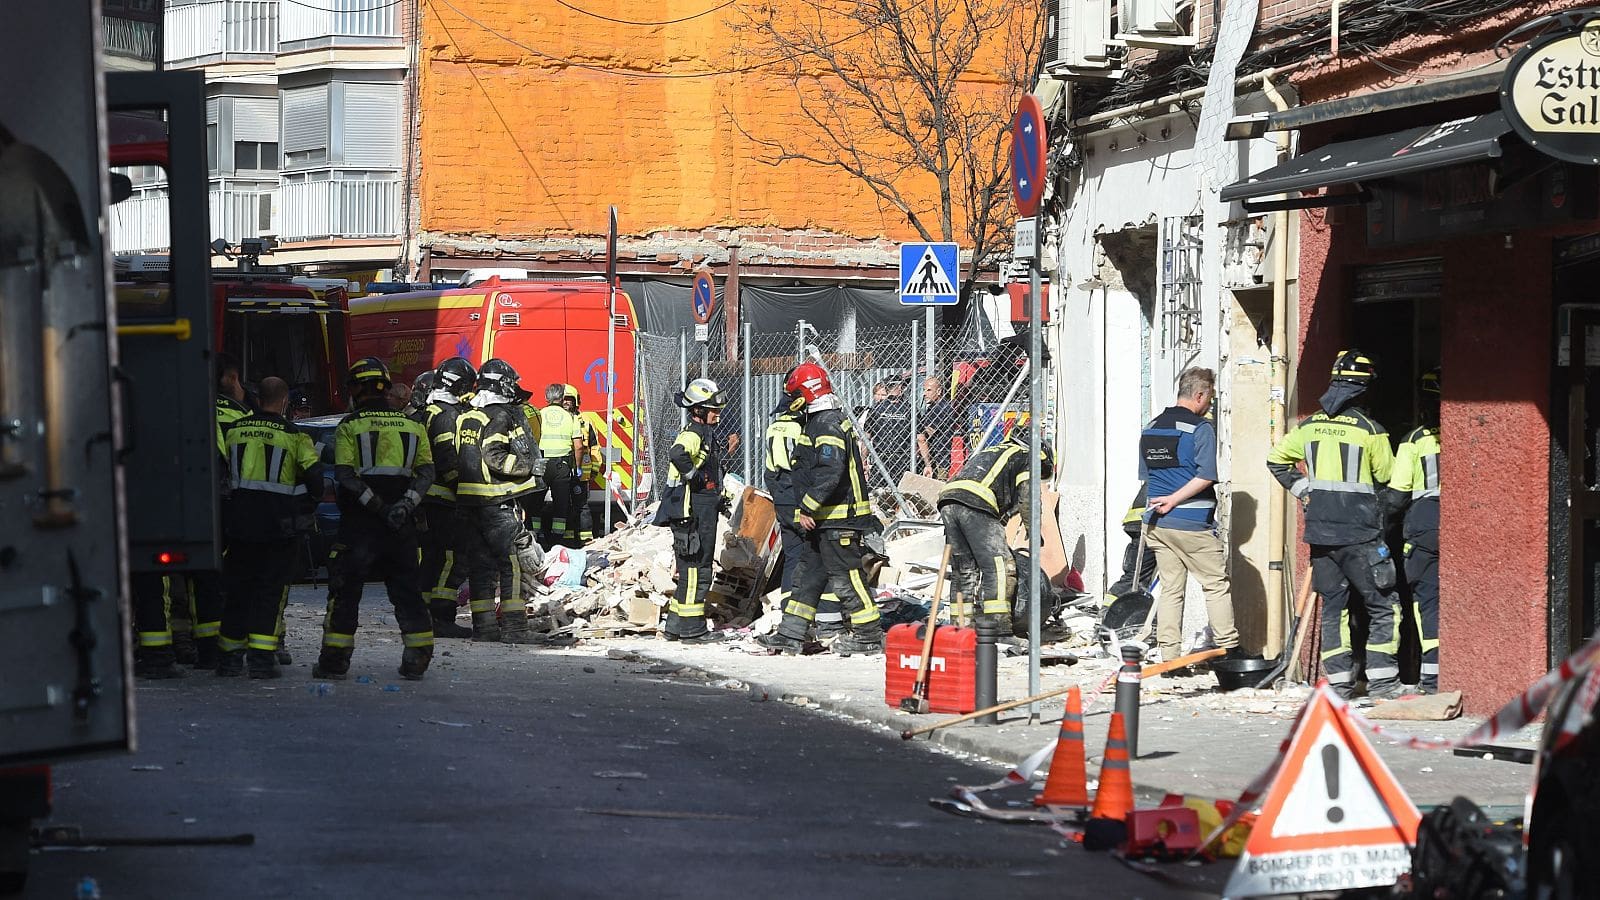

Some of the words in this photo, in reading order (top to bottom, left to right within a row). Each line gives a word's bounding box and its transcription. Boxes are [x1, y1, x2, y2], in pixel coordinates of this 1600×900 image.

[1541, 92, 1600, 125] Gal
[236, 420, 285, 430] BOMBEROS
[240, 430, 274, 440] MADRID
[1314, 427, 1346, 436] MADRID
